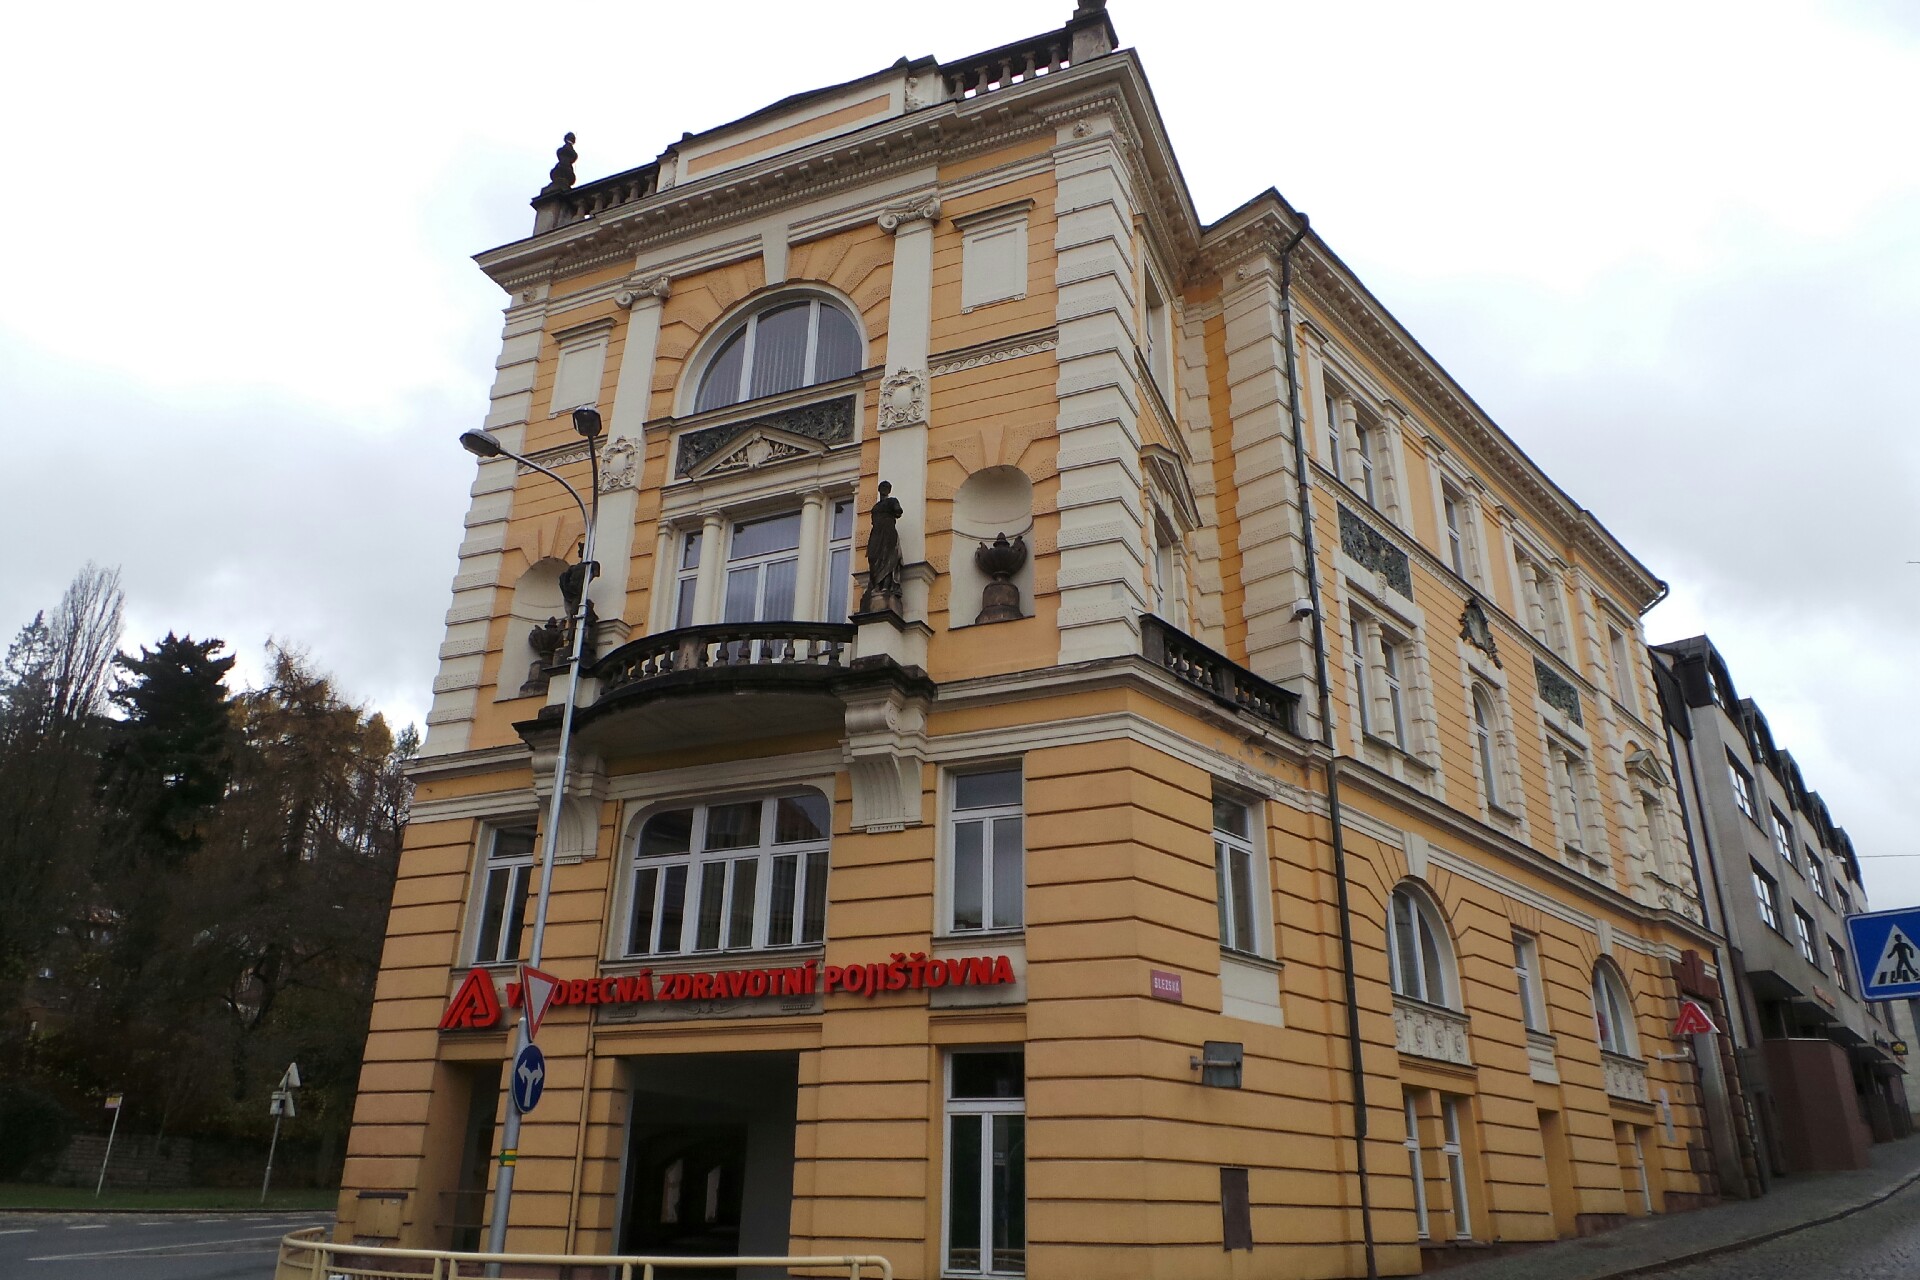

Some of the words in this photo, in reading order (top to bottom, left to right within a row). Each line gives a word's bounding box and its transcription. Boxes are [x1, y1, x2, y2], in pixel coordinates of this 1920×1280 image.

[506, 968, 654, 1008] VOBECNÁ
[657, 959, 819, 1001] ZDRAVOTNÍ
[824, 952, 1016, 998] POJIŠŤOVNA
